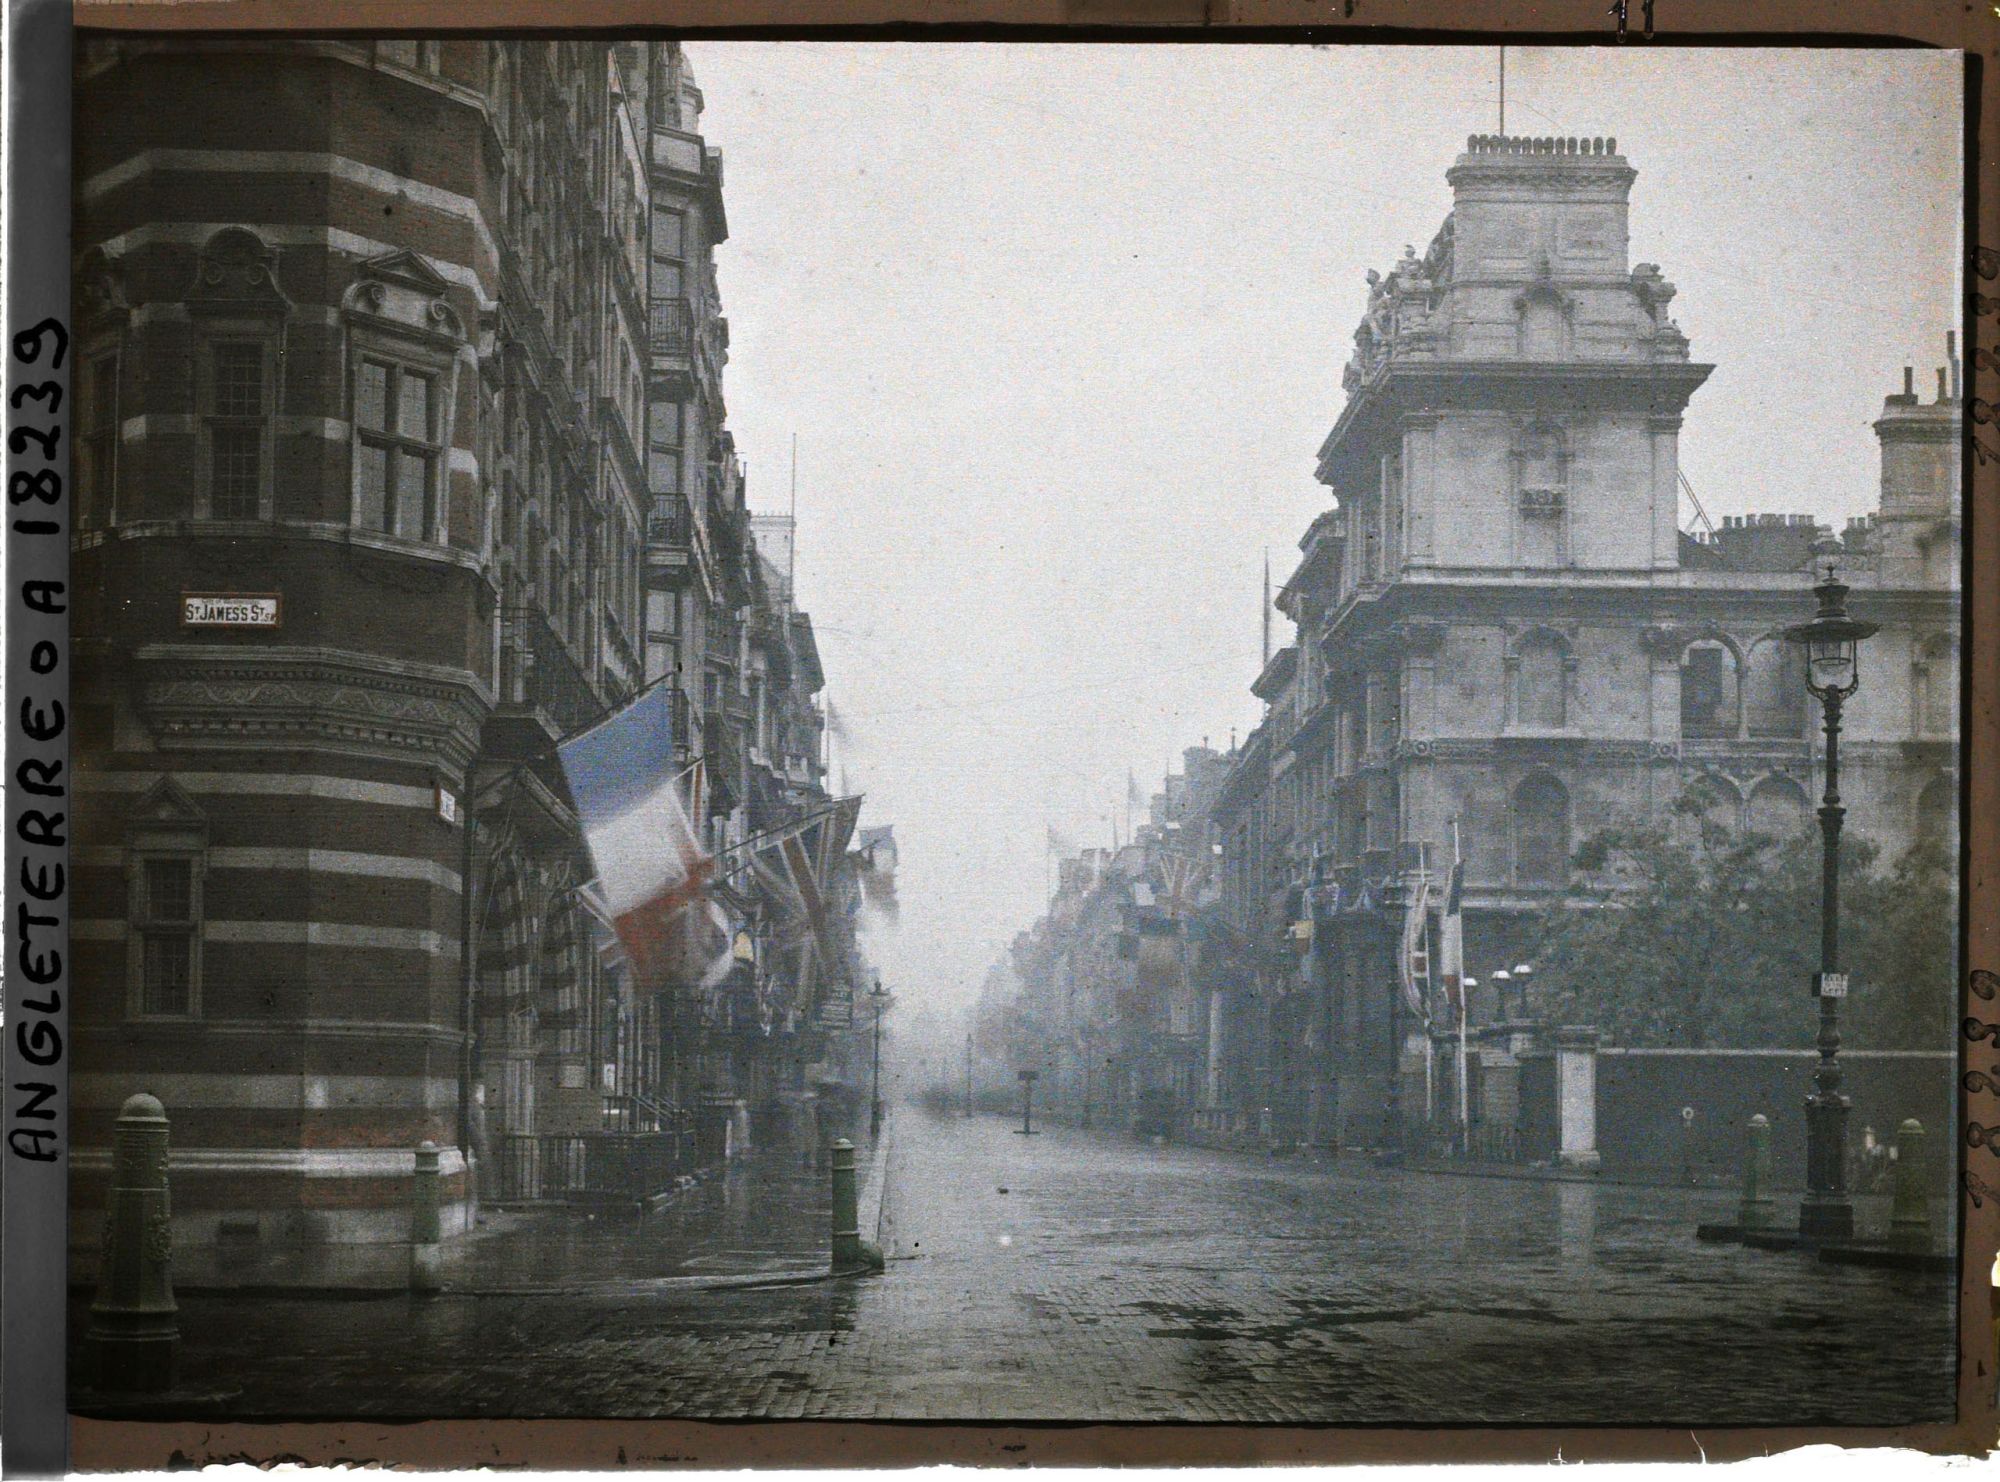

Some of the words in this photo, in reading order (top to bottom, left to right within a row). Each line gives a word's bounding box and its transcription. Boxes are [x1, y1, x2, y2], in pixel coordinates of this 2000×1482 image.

[8, 317, 68, 535] 18239
[22, 580, 67, 614] A
[8, 696, 66, 1162] ANGLETERRE
